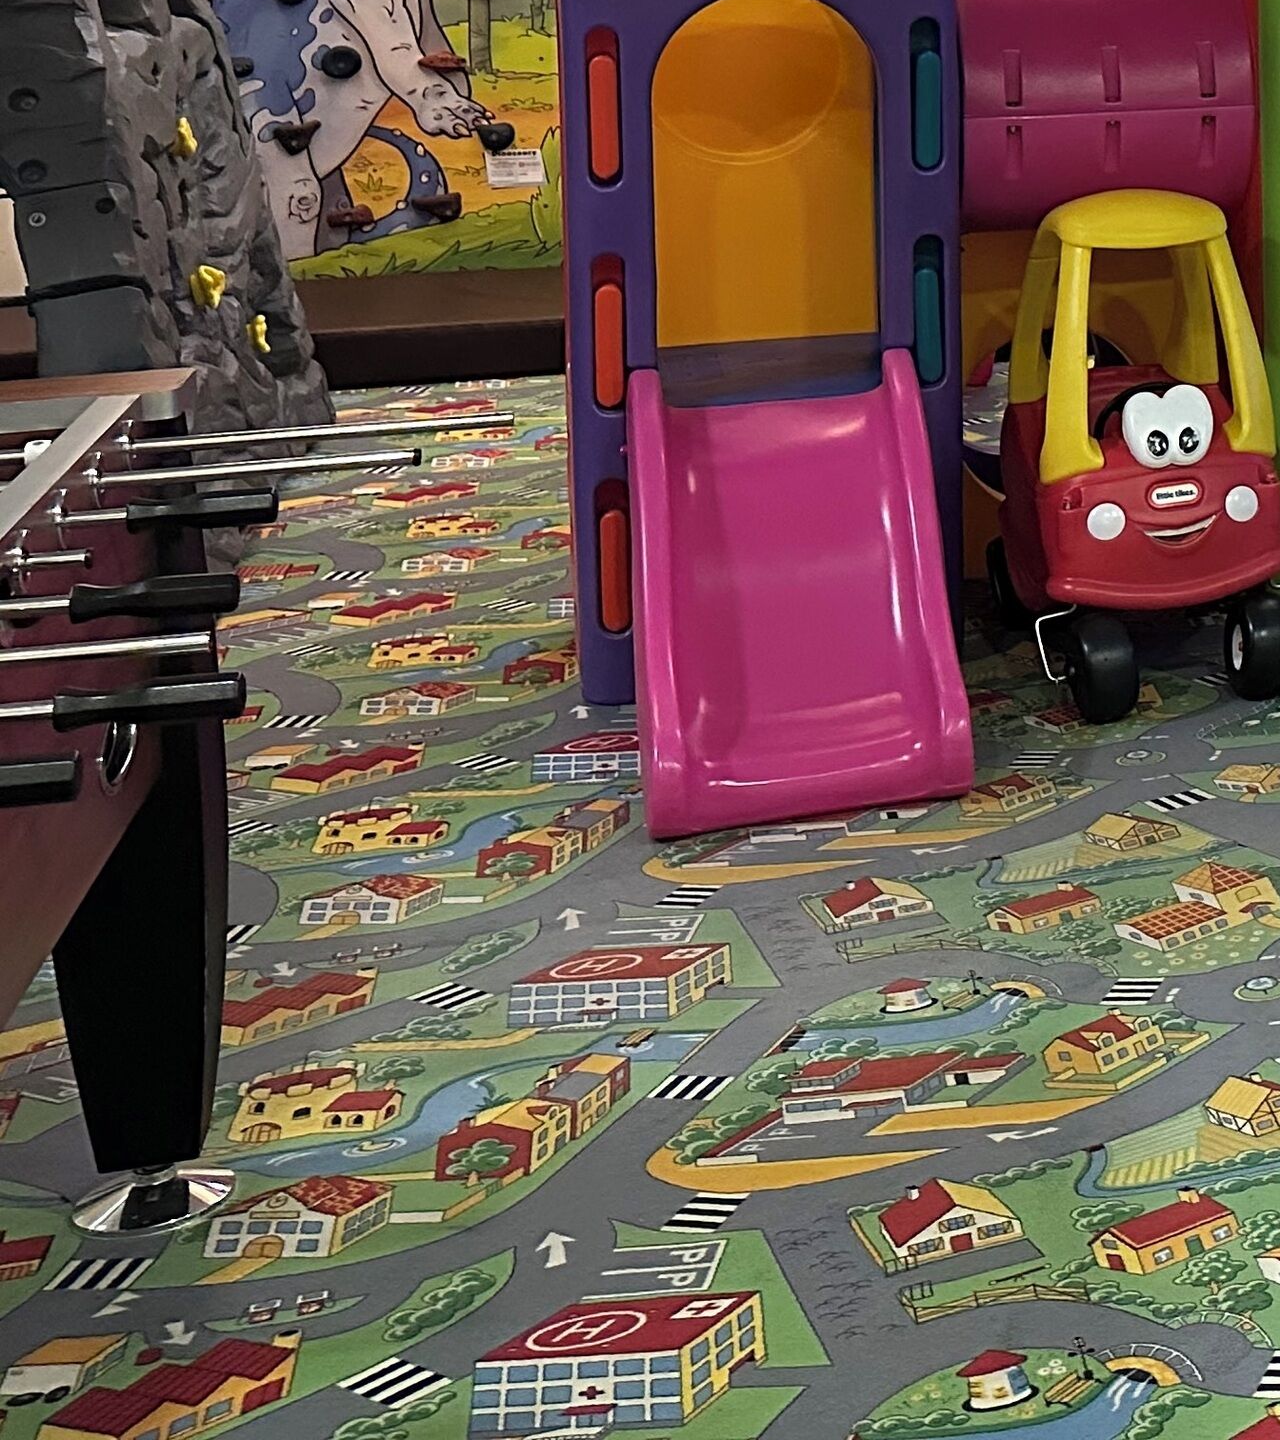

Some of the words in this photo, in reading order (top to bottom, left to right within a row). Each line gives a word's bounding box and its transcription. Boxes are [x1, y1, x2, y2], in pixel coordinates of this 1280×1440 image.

[570, 958, 619, 974] H
[670, 1248, 708, 1263] P
[657, 1271, 697, 1287] P
[551, 1318, 616, 1343] H
